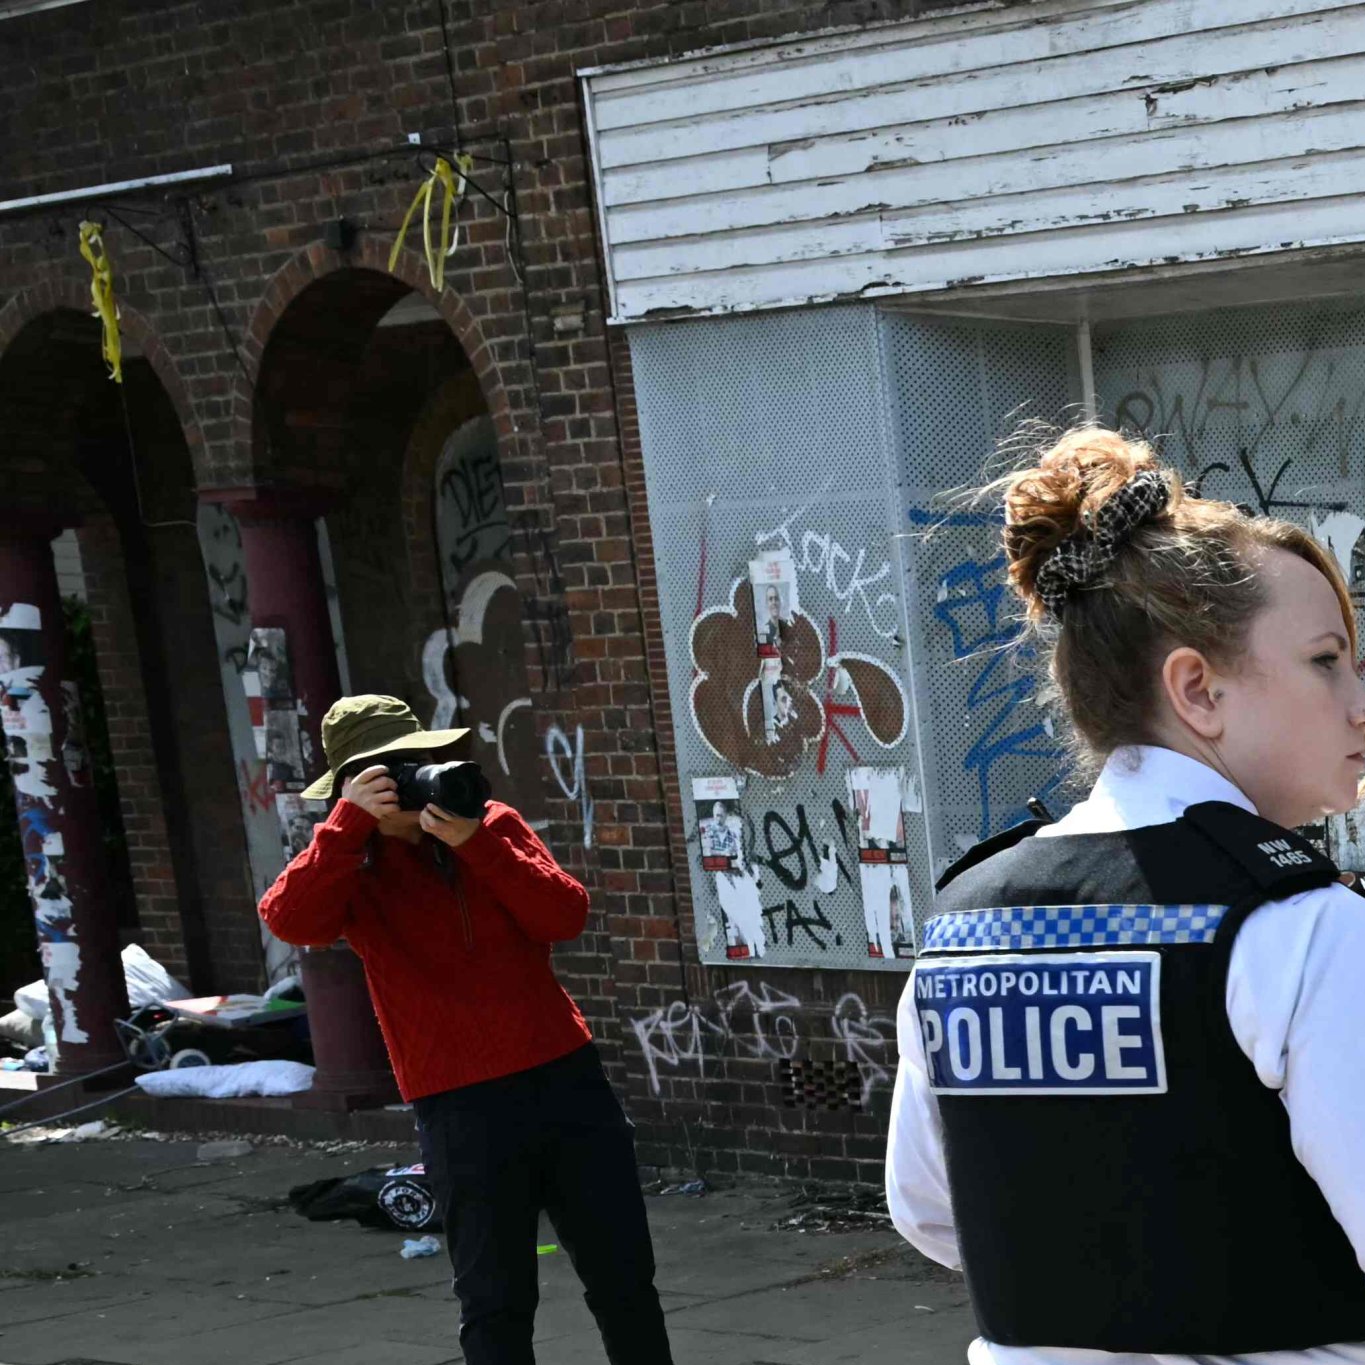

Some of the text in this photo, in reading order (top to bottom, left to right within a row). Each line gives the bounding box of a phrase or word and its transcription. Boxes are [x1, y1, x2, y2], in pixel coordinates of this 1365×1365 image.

[1257, 839, 1291, 855] NW
[1269, 850, 1313, 868] 1465
[915, 968, 1142, 1001] METROPOLITAN
[925, 1003, 1149, 1082] POLICE
